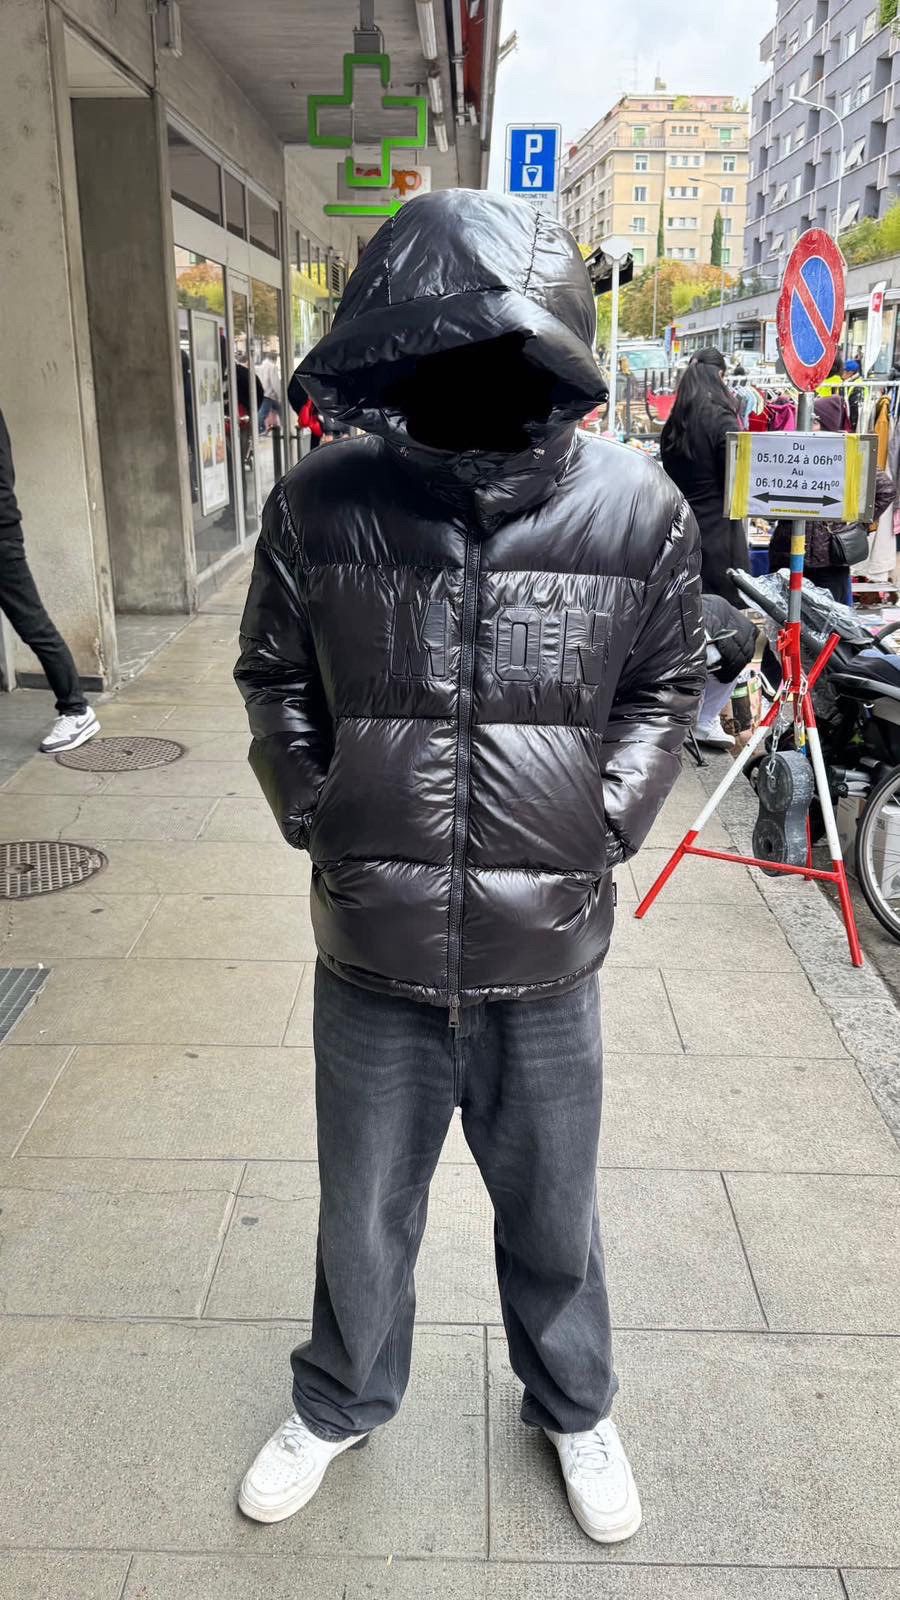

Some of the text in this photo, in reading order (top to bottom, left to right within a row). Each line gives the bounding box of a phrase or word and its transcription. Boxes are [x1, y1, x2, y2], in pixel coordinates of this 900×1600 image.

[525, 133, 543, 164] P
[792, 442, 806, 451] Du
[757, 453, 800, 465] 05.10.24
[803, 454, 810, 465] à
[791, 467, 804, 476] Au
[755, 477, 799, 489] 06.10.24
[801, 479, 808, 490] à
